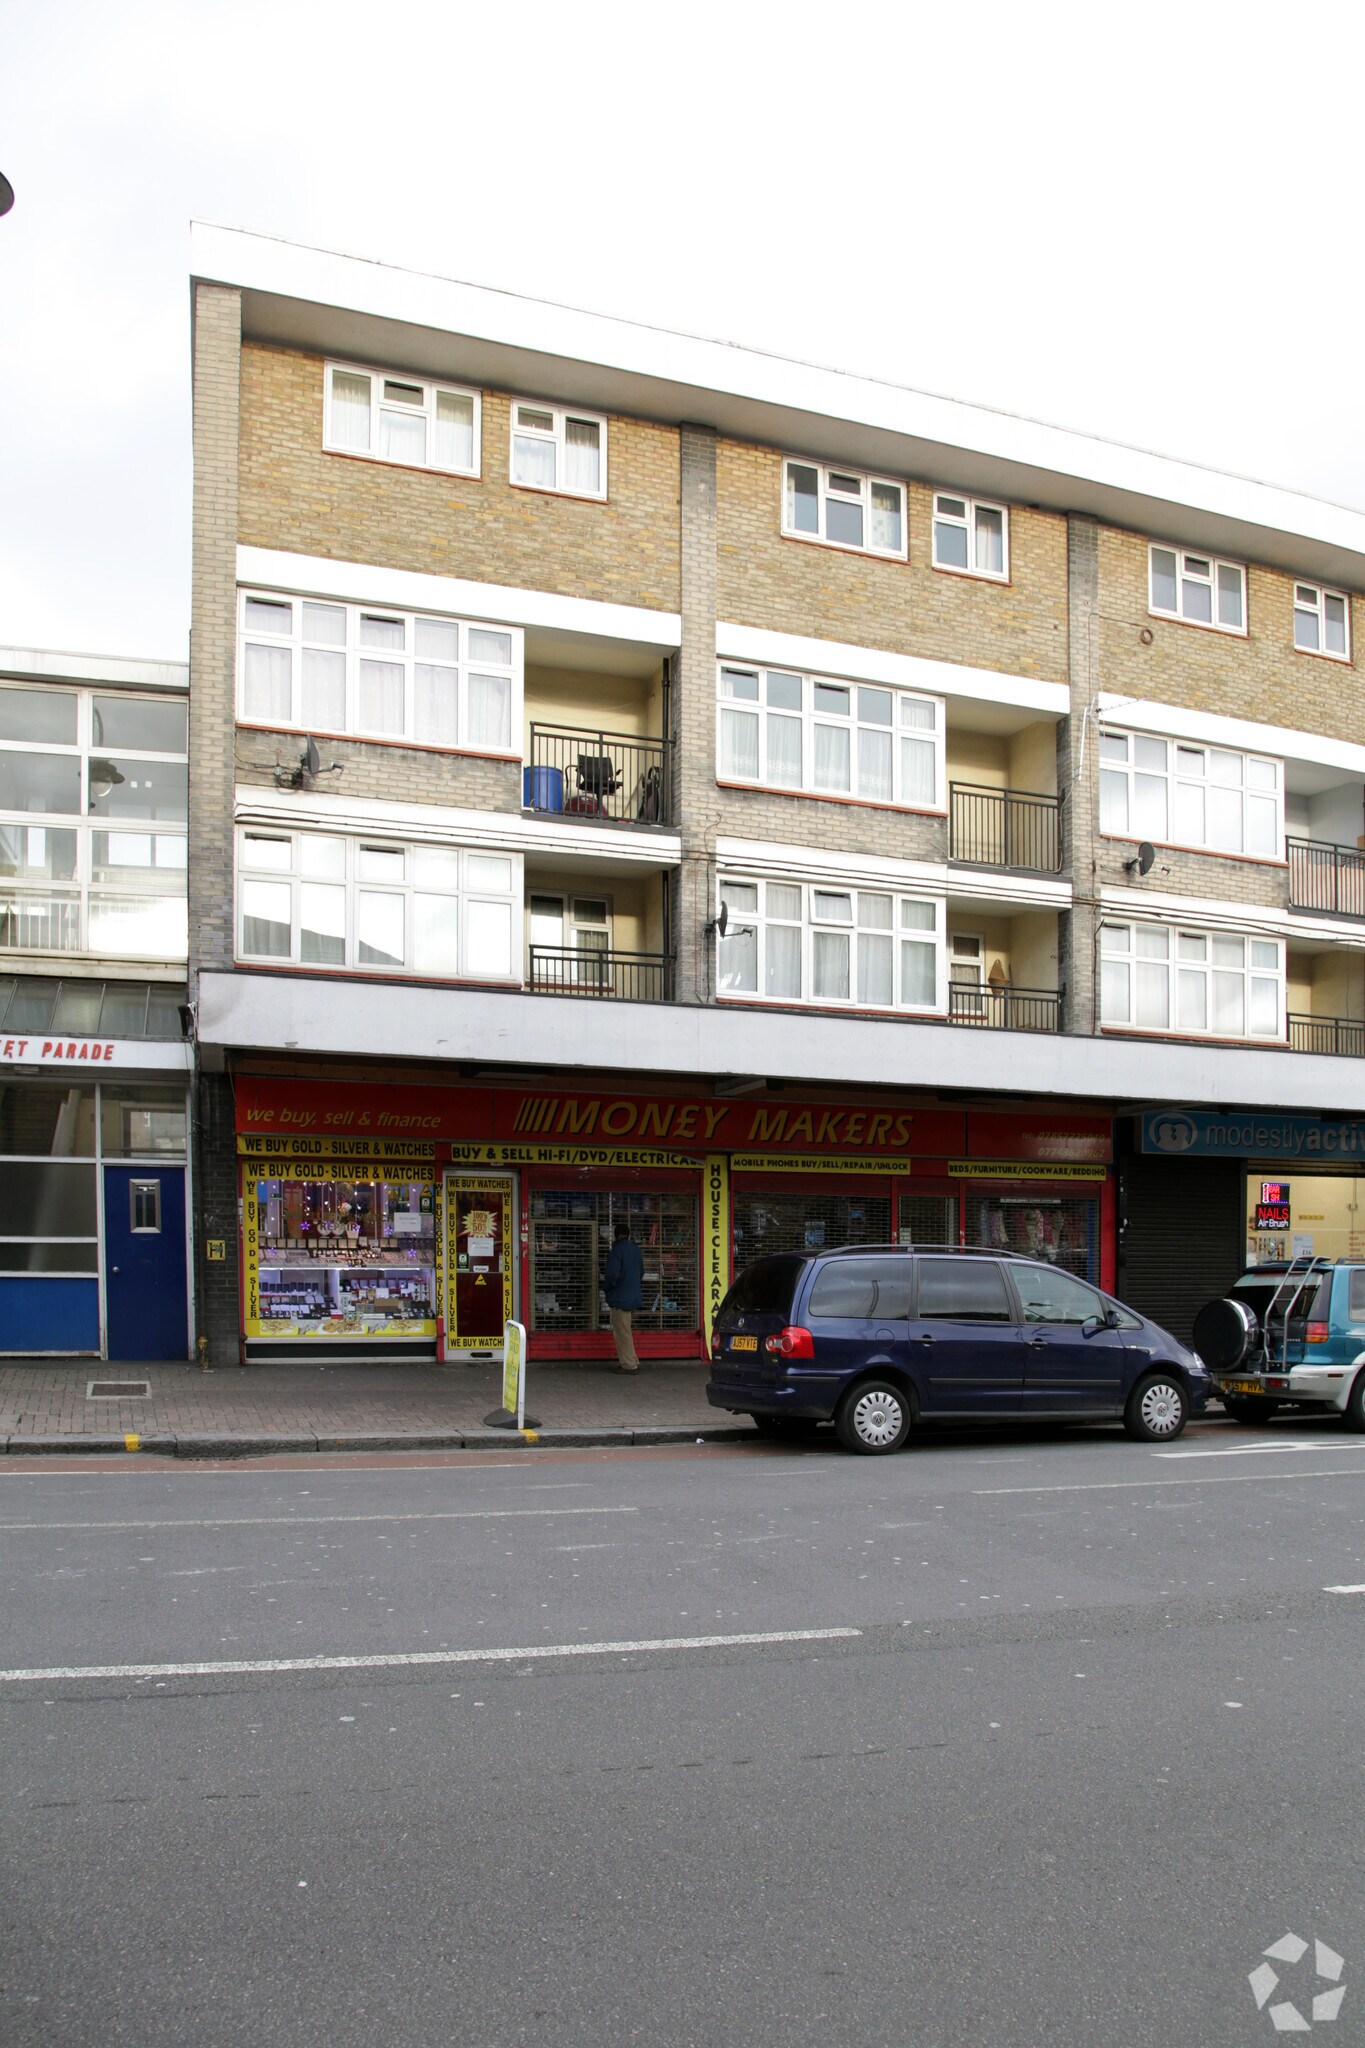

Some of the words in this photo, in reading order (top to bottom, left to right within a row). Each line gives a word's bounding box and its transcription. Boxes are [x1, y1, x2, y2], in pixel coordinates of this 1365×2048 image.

[0, 1040, 28, 1058] ET
[41, 1042, 115, 1061] PARADE
[247, 1109, 275, 1122] we
[323, 1110, 355, 1126] sell
[358, 1112, 372, 1126] &
[377, 1112, 442, 1128] finance
[245, 1138, 262, 1152] WE
[266, 1139, 289, 1153] BUY
[292, 1140, 322, 1154] GOLD
[332, 1141, 370, 1155] SILVER
[373, 1143, 381, 1155] &
[384, 1143, 435, 1157] WATCHES
[452, 1147, 484, 1160] BUY
[486, 1147, 496, 1160] &
[501, 1148, 534, 1161] SELL
[538, 1149, 704, 1167] HI-FI/DVD/ELECTRICA
[733, 1158, 765, 1167] MOBILE
[767, 1159, 799, 1168] PHONES
[248, 1163, 265, 1177] WE
[269, 1164, 291, 1178] BUY
[331, 1166, 369, 1179] SILVER
[372, 1167, 380, 1180] &
[383, 1167, 434, 1181] WATCHES
[247, 1181, 256, 1195] WE
[449, 1178, 460, 1188] WE
[462, 1179, 475, 1189] BUY
[477, 1179, 510, 1190] WATCHES
[448, 1191, 456, 1206] WE
[503, 1192, 511, 1206] WE
[248, 1201, 256, 1222] BUY
[1258, 1207, 1289, 1220] NAILS
[1258, 1219, 1268, 1228] Air
[1269, 1219, 1289, 1228] Brush
[450, 1338, 461, 1347] WE
[463, 1338, 477, 1347] BUY
